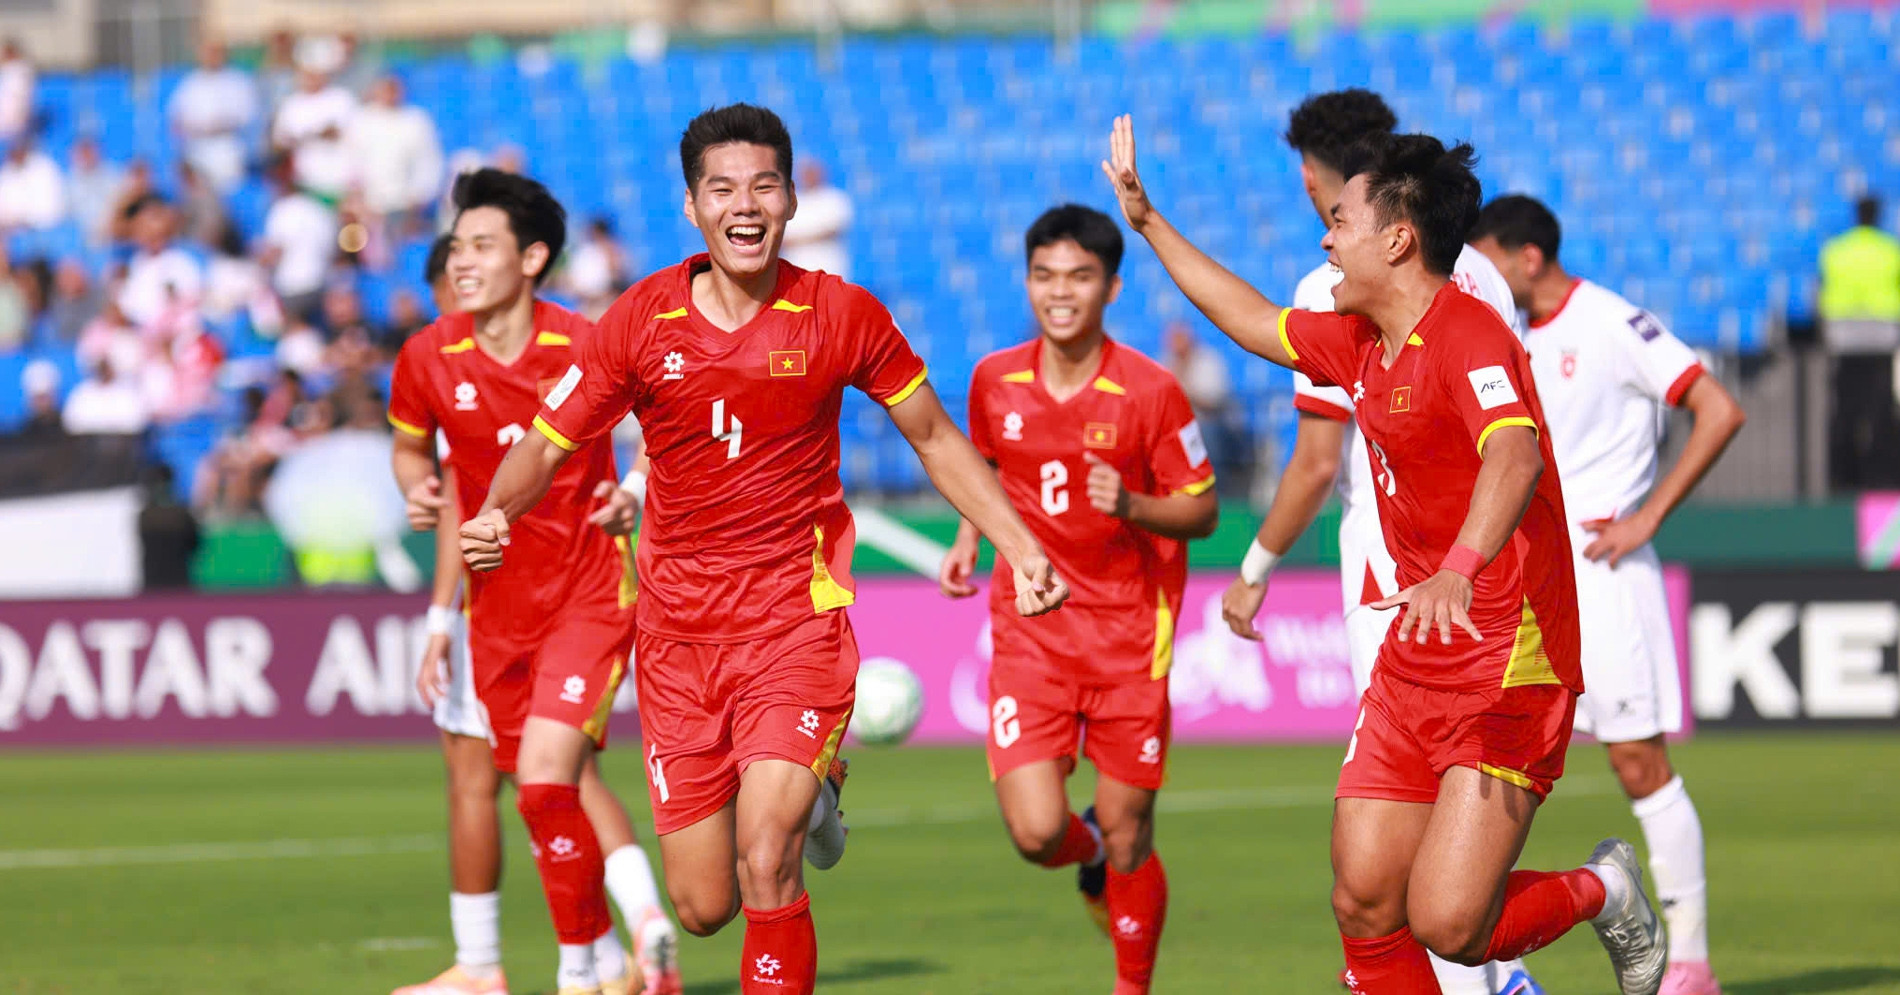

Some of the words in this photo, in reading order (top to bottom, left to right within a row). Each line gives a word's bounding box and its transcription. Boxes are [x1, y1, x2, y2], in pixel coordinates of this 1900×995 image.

[1480, 379, 1506, 394] AFC
[711, 398, 743, 459] 4
[1040, 459, 1069, 516] 2
[1371, 439, 1397, 497] 3
[1691, 600, 1900, 720] KE
[992, 695, 1021, 749] 2
[648, 743, 670, 804] 4
